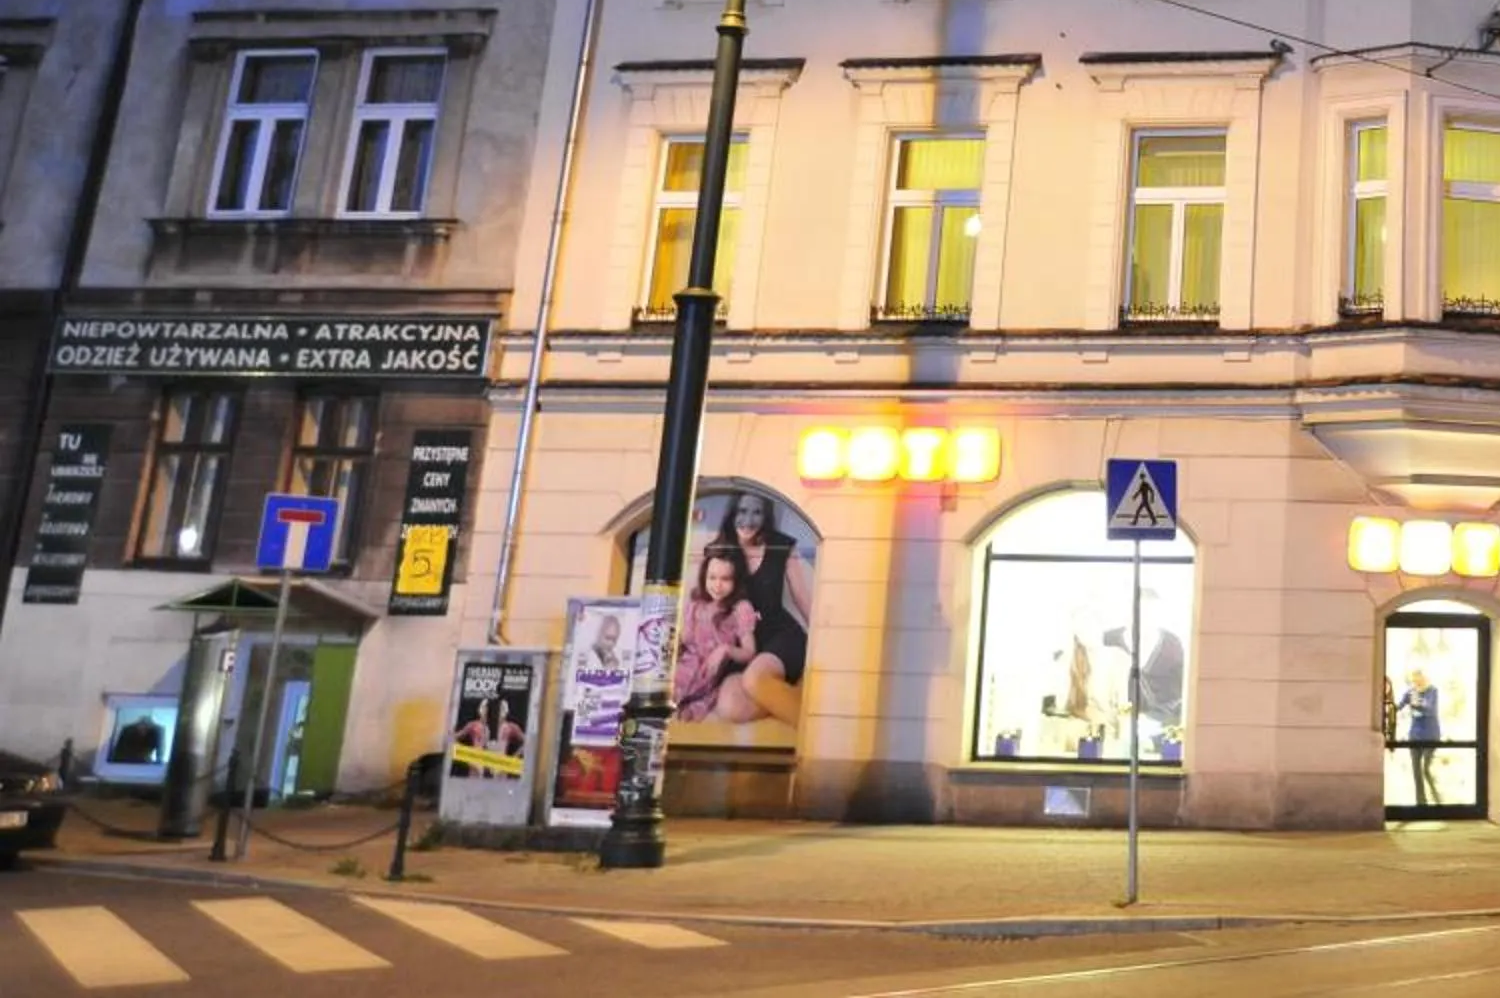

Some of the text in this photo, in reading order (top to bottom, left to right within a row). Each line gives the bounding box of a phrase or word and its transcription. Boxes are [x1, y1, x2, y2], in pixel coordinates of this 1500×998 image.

[62, 320, 481, 342] NIEPOWTARZALNA ATRAKCYJNA
[56, 340, 479, 371] ODZIEŻ UŻYWANA EXTRA JAKOŚĆ
[59, 433, 82, 451] TU
[423, 471, 451, 488] CENY
